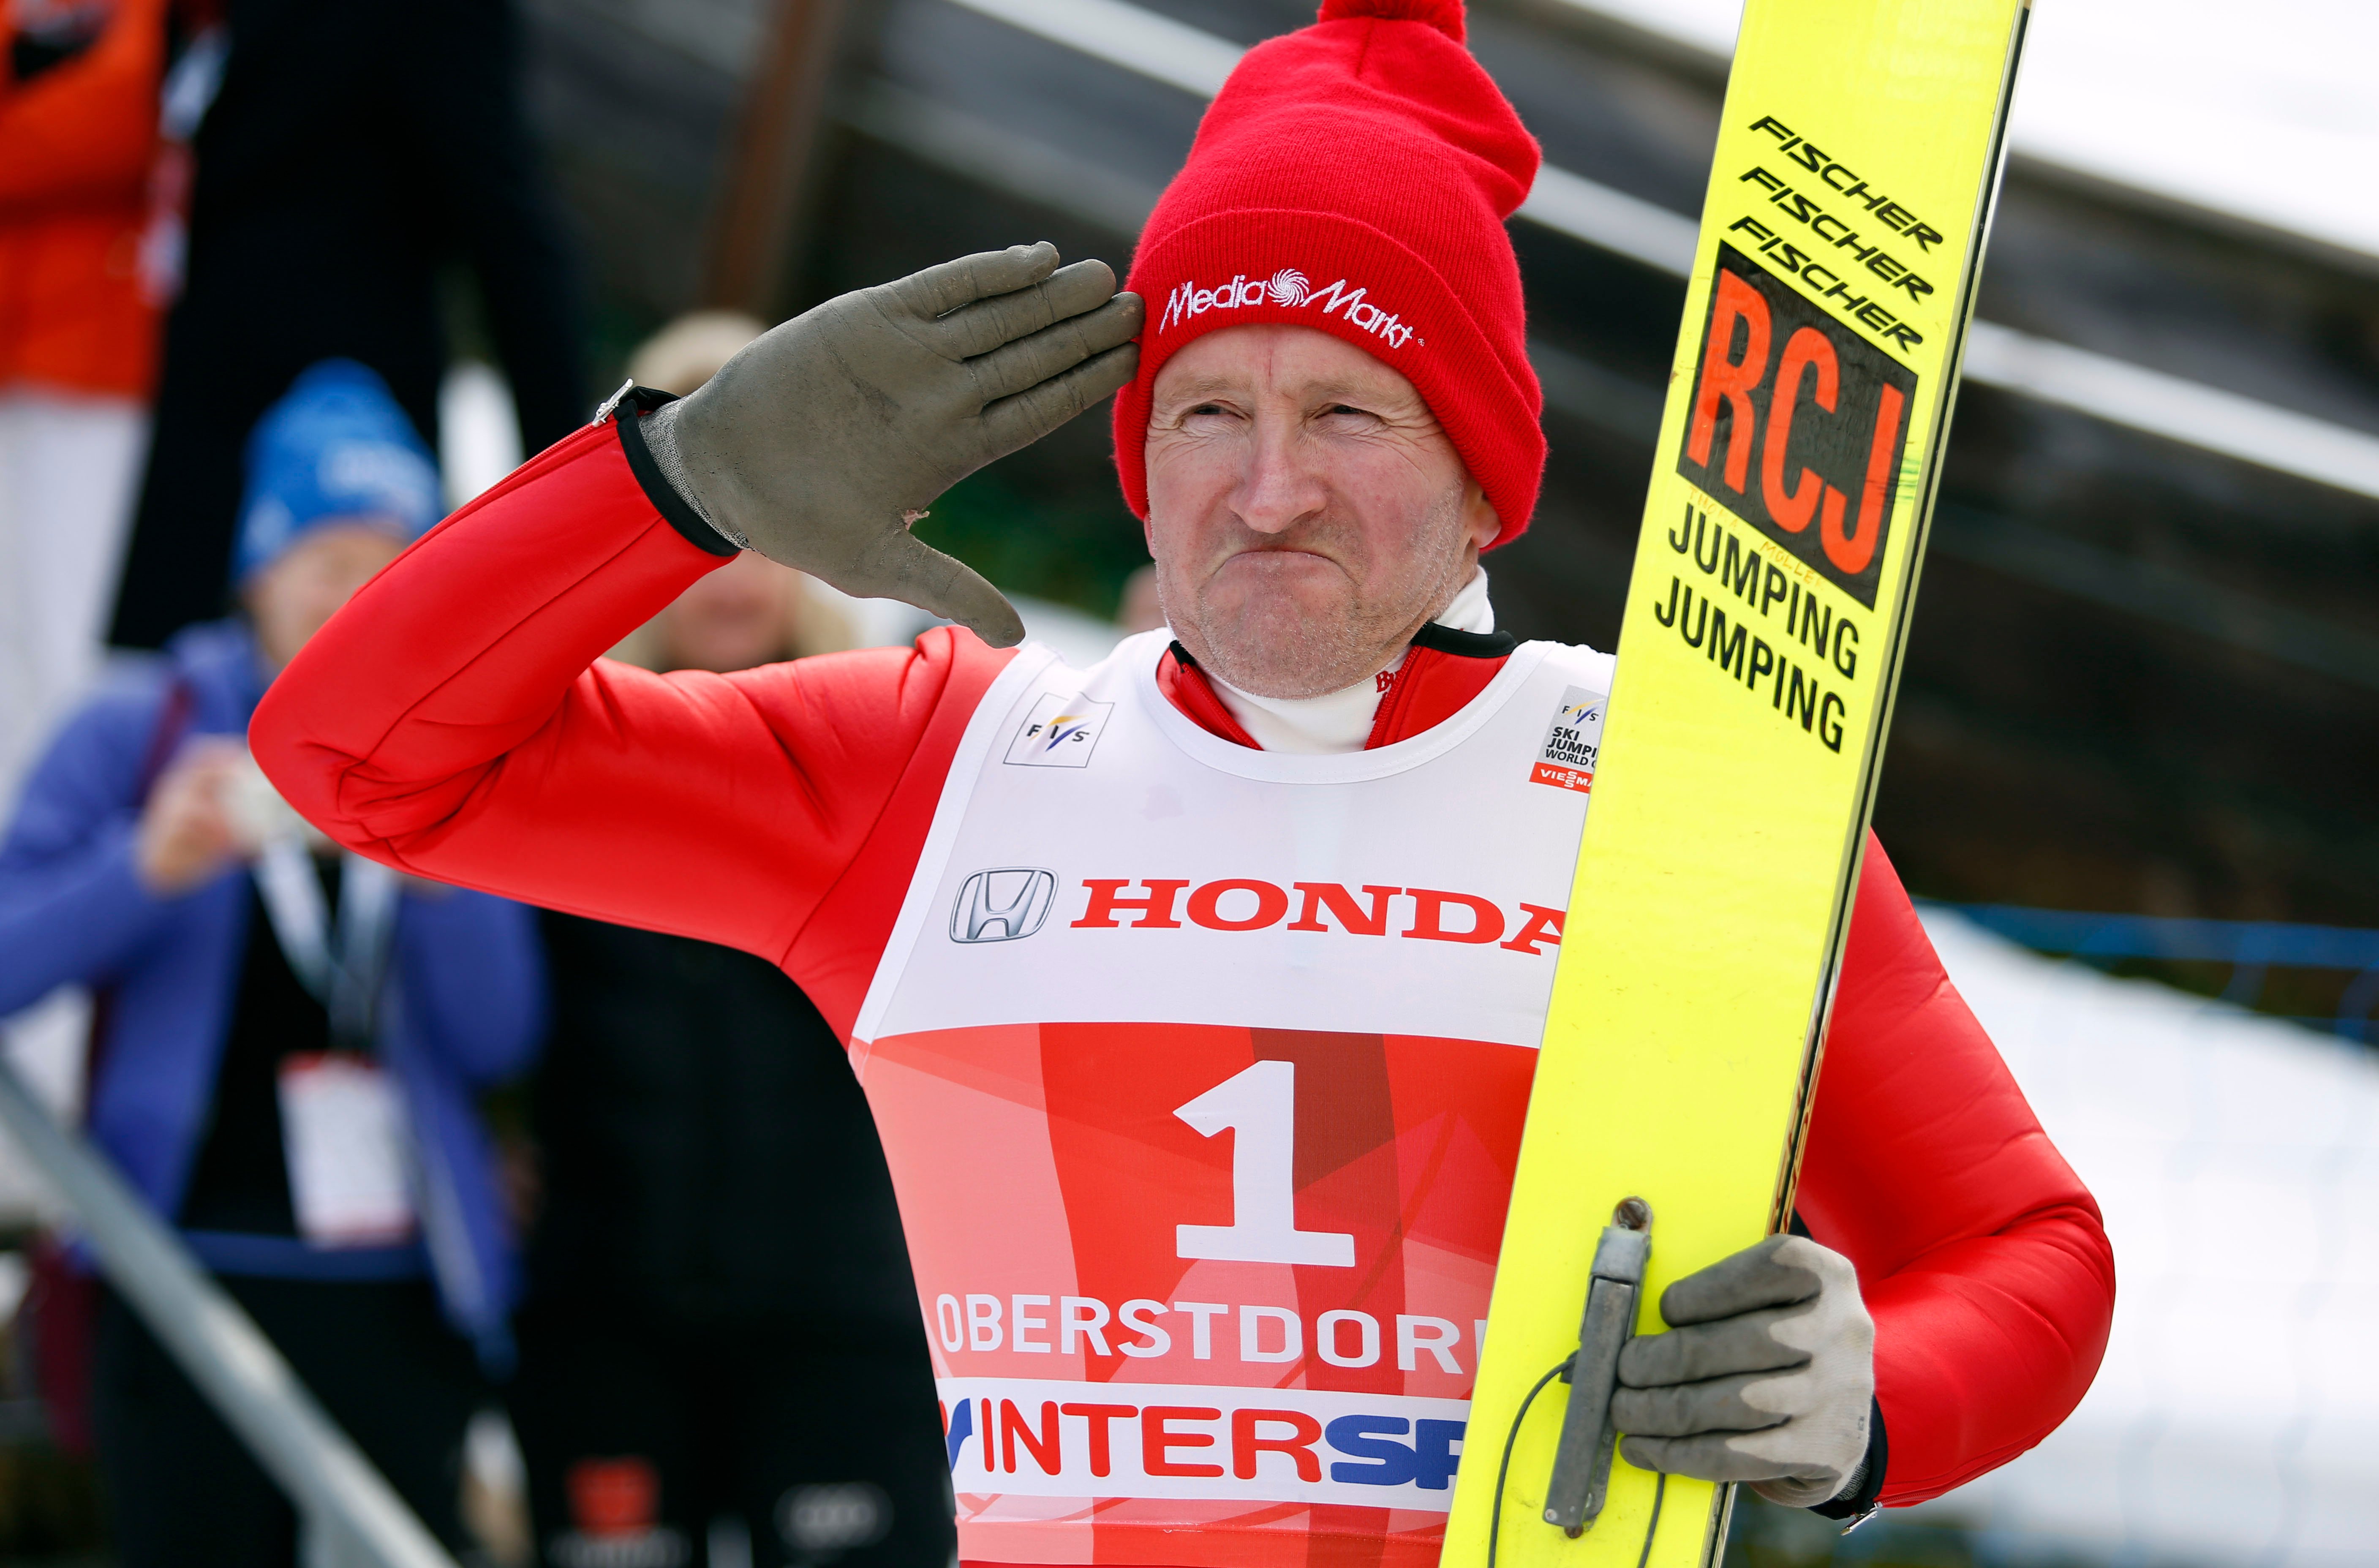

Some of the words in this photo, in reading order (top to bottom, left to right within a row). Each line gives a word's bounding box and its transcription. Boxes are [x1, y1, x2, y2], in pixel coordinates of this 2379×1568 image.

[1738, 166, 1934, 305] FISCHER
[1748, 115, 1943, 254] FISCHER
[1159, 275, 1268, 336] Media
[1300, 278, 1413, 349] Markt
[1728, 215, 1923, 354] FISCHER
[1687, 267, 1905, 574] RCJ
[1669, 502, 1859, 680] JUMPING
[1552, 726, 1580, 741] SKI
[1655, 575, 1845, 754] JUMPING
[1545, 749, 1589, 766] WORLD
[1547, 738, 1598, 758] JUMPI
[1070, 878, 1566, 956] HONDA
[1172, 1059, 1356, 1268] 1
[936, 1293, 1487, 1375] OBERSTDOR
